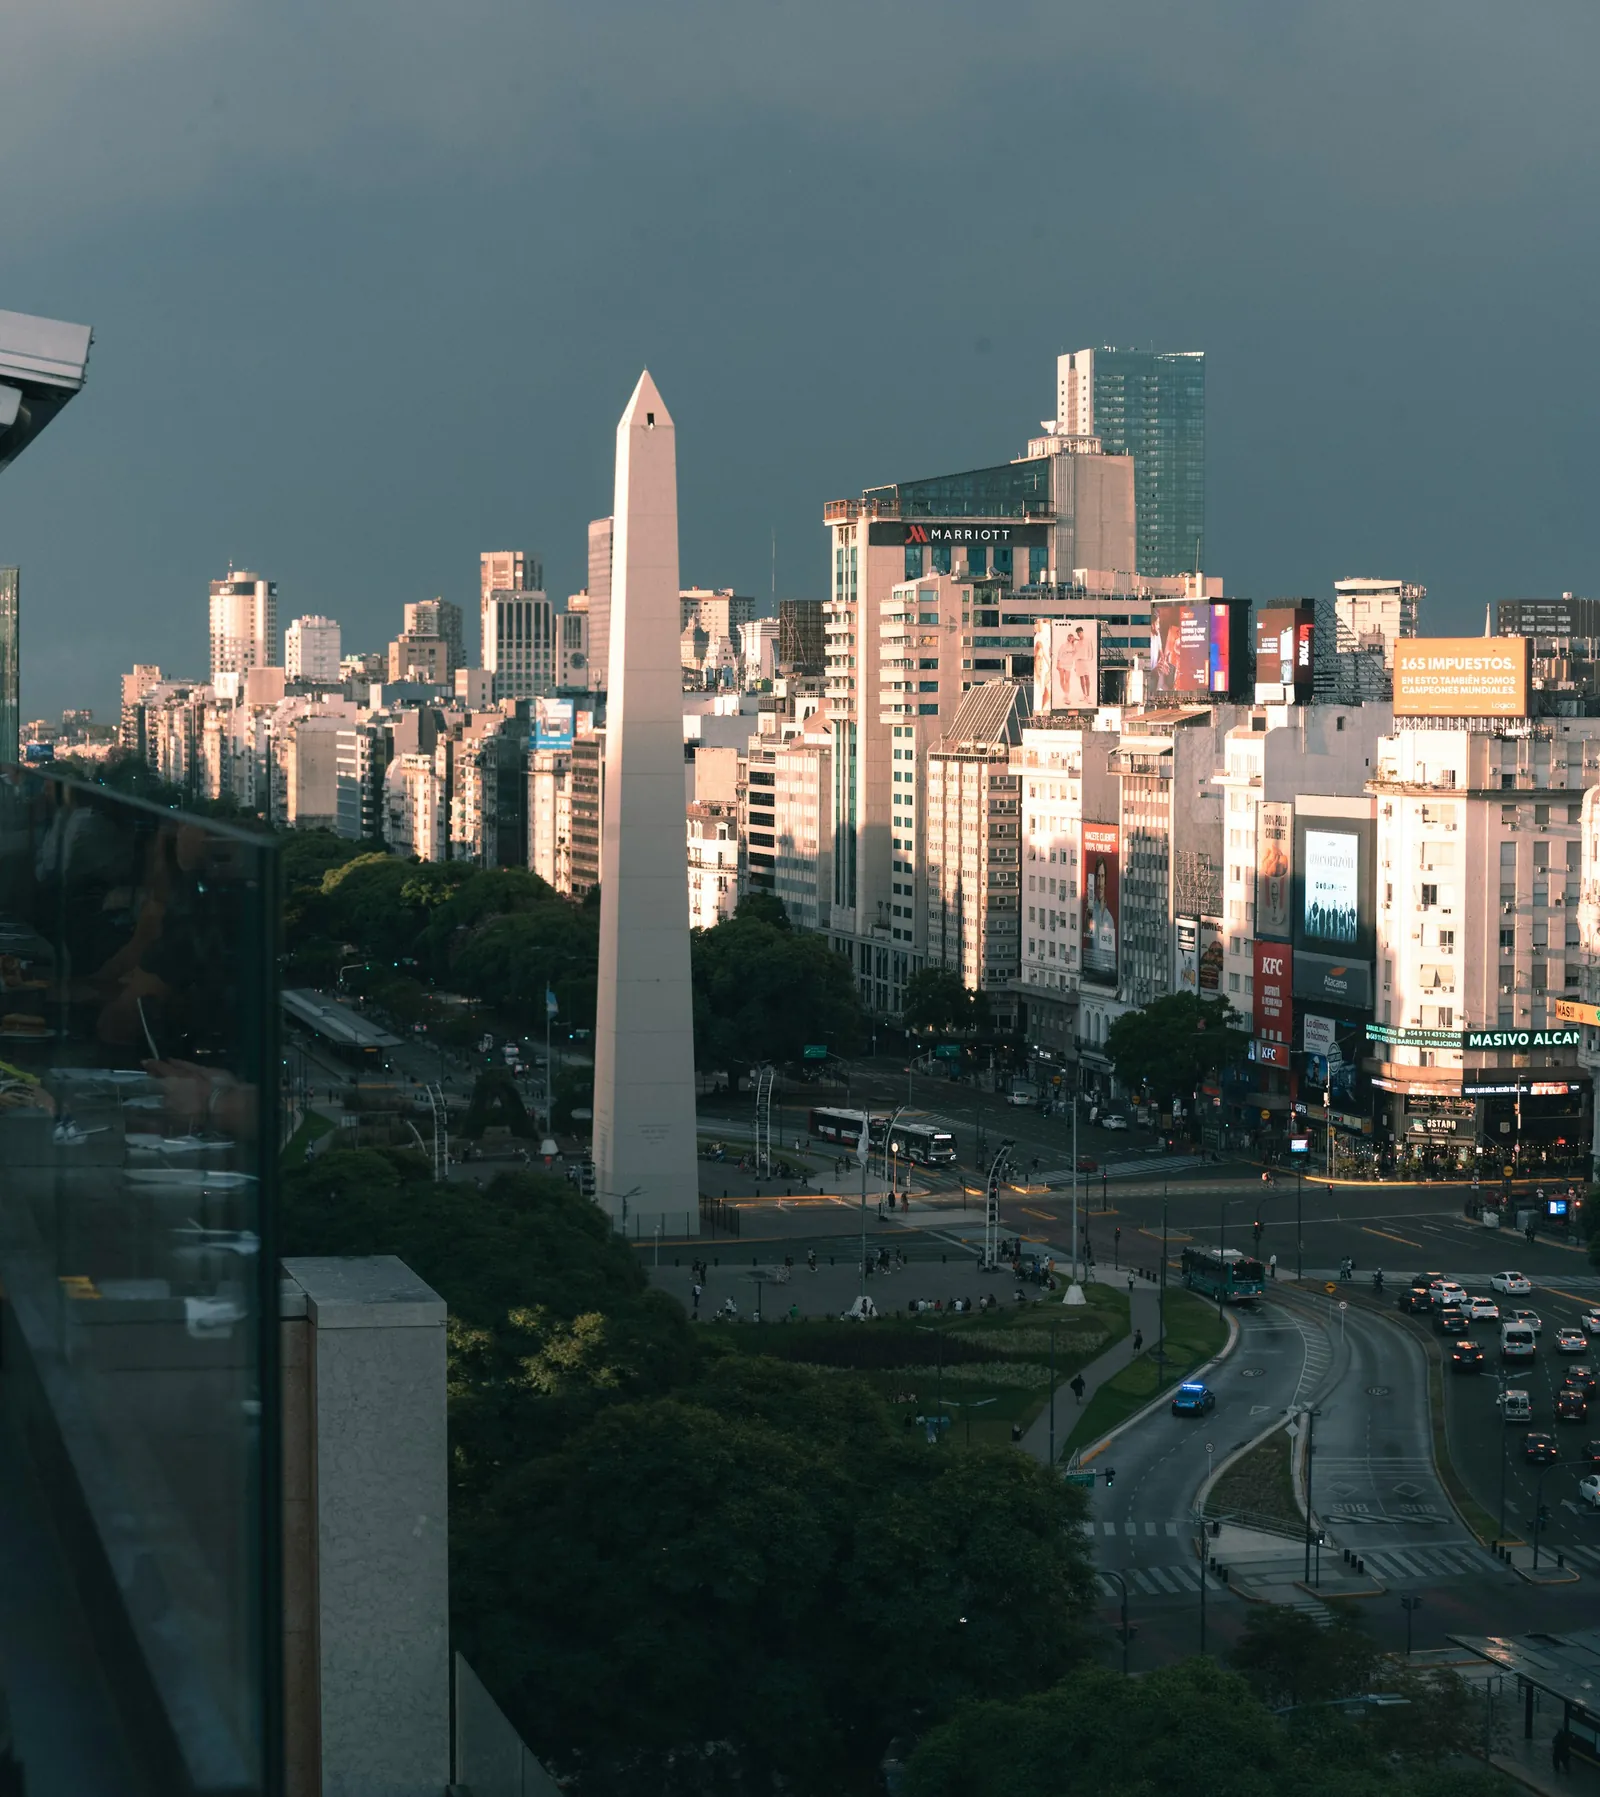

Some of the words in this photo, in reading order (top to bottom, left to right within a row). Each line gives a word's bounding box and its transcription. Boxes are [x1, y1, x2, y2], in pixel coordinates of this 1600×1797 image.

[931, 529, 1010, 541] MARRIOTT
[1401, 657, 1426, 671] 165
[1427, 657, 1516, 671] IMPUESTOS.
[1401, 676, 1414, 685] EN
[1415, 676, 1439, 685] ESTO
[1440, 674, 1480, 685] TAMBIÉN
[1481, 676, 1516, 685] SOMOS
[1402, 686, 1459, 694] CAMPEONES
[1460, 686, 1516, 695] MUNDIALES.
[1262, 956, 1283, 975] KFC
[1324, 975, 1348, 989] Atacama
[1397, 1038, 1424, 1046] BARUJEL
[1424, 1039, 1462, 1048] PUBLICIDAD
[1469, 1033, 1529, 1047] MASIVO
[1261, 1046, 1277, 1060] KFC
[1425, 1119, 1457, 1131] OSTADO
[1331, 1503, 1370, 1513] BUS
[1400, 1503, 1437, 1513] BUS
